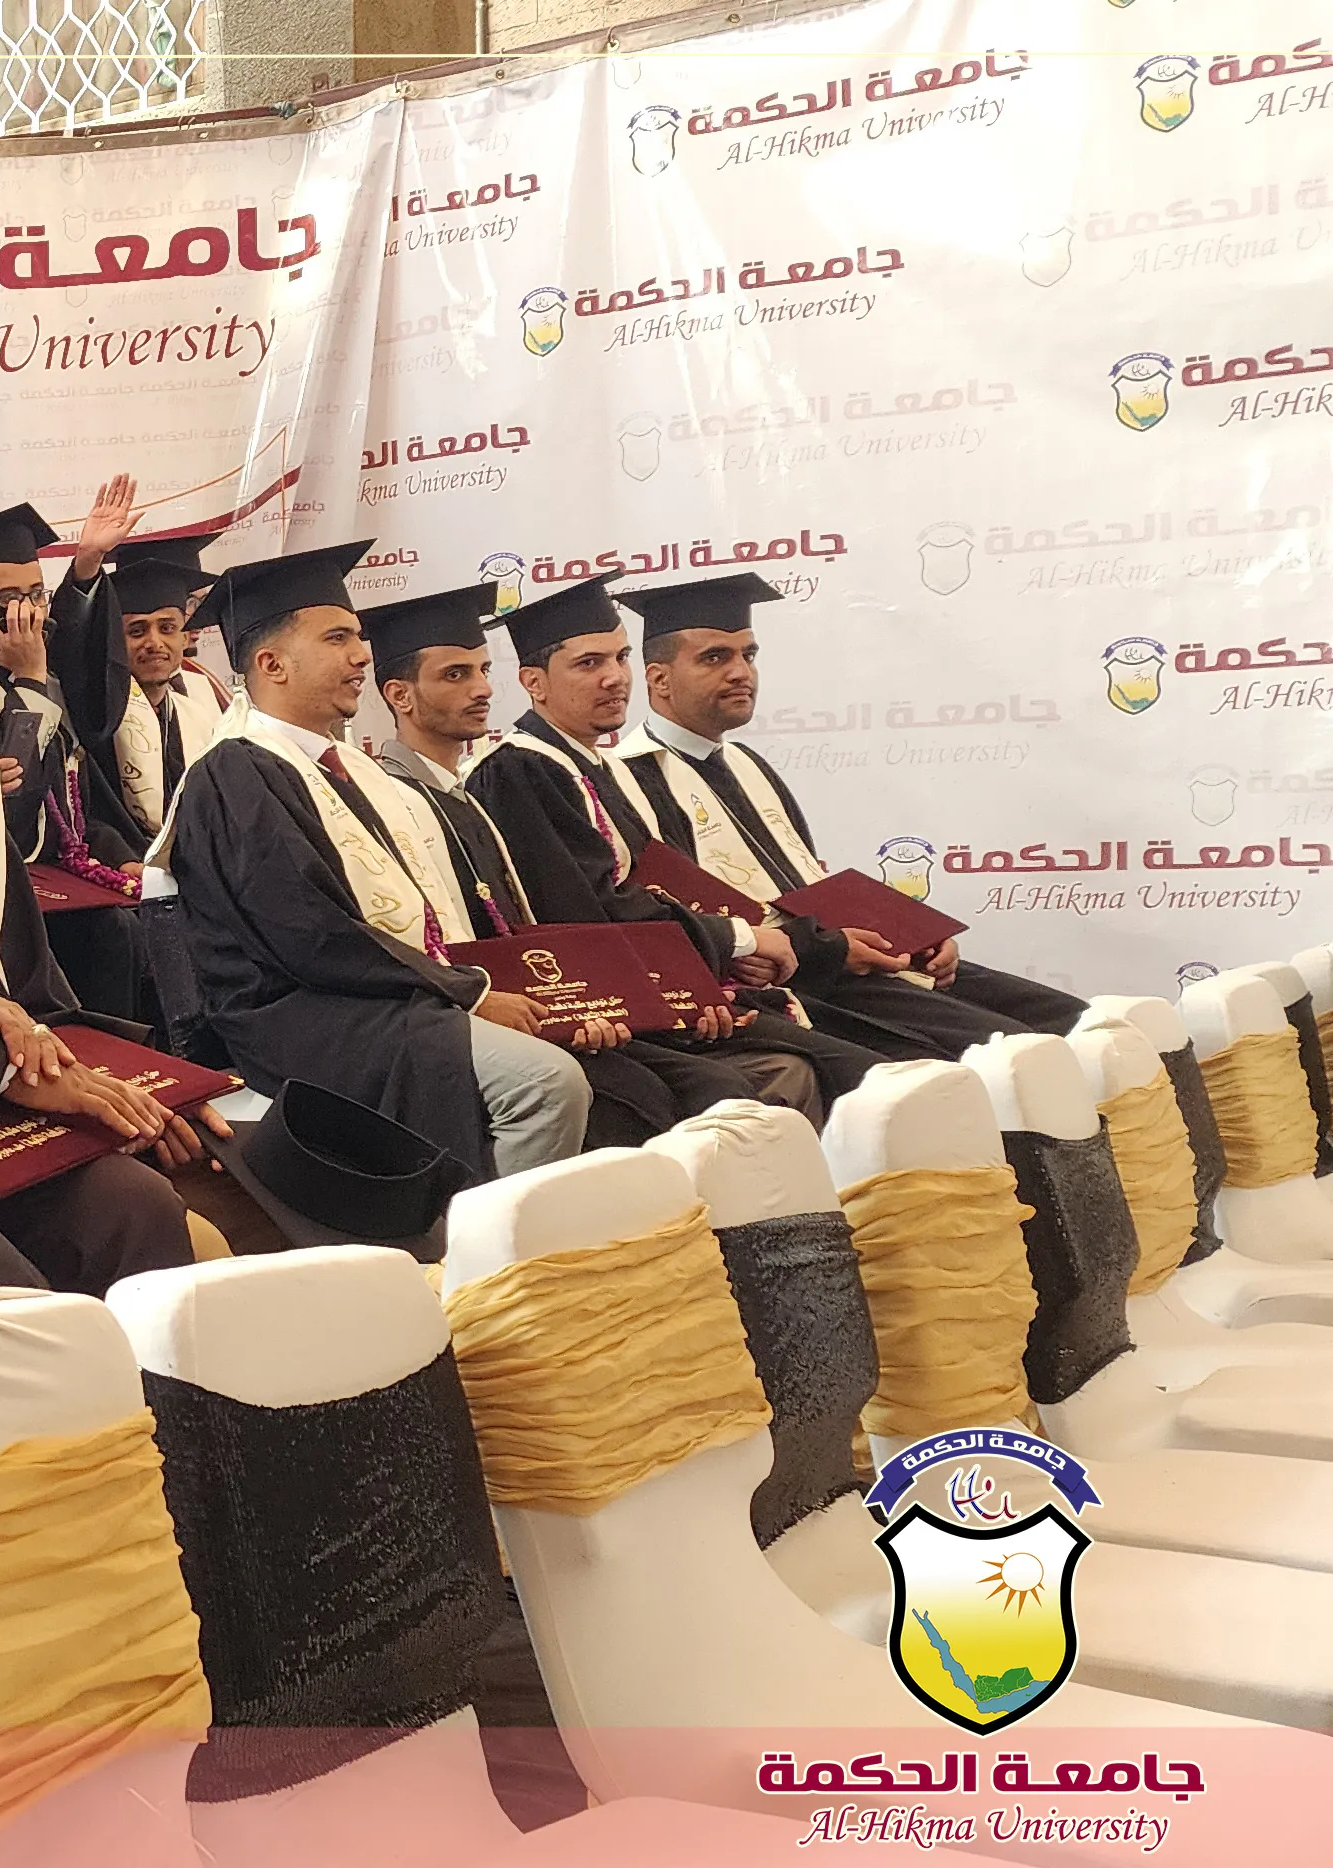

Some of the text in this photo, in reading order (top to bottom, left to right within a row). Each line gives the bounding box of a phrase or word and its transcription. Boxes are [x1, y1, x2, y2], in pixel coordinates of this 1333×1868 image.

[688, 48, 1032, 136] جامعة الحكمة
[1245, 81, 1333, 124] Al-H
[717, 119, 851, 171] Al-Hikma
[408, 172, 541, 217] جامعة
[1084, 184, 1280, 242] الحكمة
[405, 214, 519, 251] University
[574, 245, 905, 317] جامعة الحكمة
[603, 290, 876, 352] Al-Hikma University
[1182, 343, 1333, 387] حكمة
[843, 377, 1018, 420] جامعة
[1219, 382, 1333, 428] Al-Hik
[407, 423, 530, 463] جامعة
[405, 463, 508, 497] University
[354, 546, 421, 570] جامع
[532, 529, 847, 584] جامعة الحكمة
[1175, 636, 1333, 674] حكمة
[885, 694, 1061, 731] جامعة
[1210, 677, 1333, 716] Al-Hik
[882, 737, 1031, 771] University
[943, 836, 1333, 875] جامعة الحكمة
[975, 879, 1301, 918] Al-Hikma University
